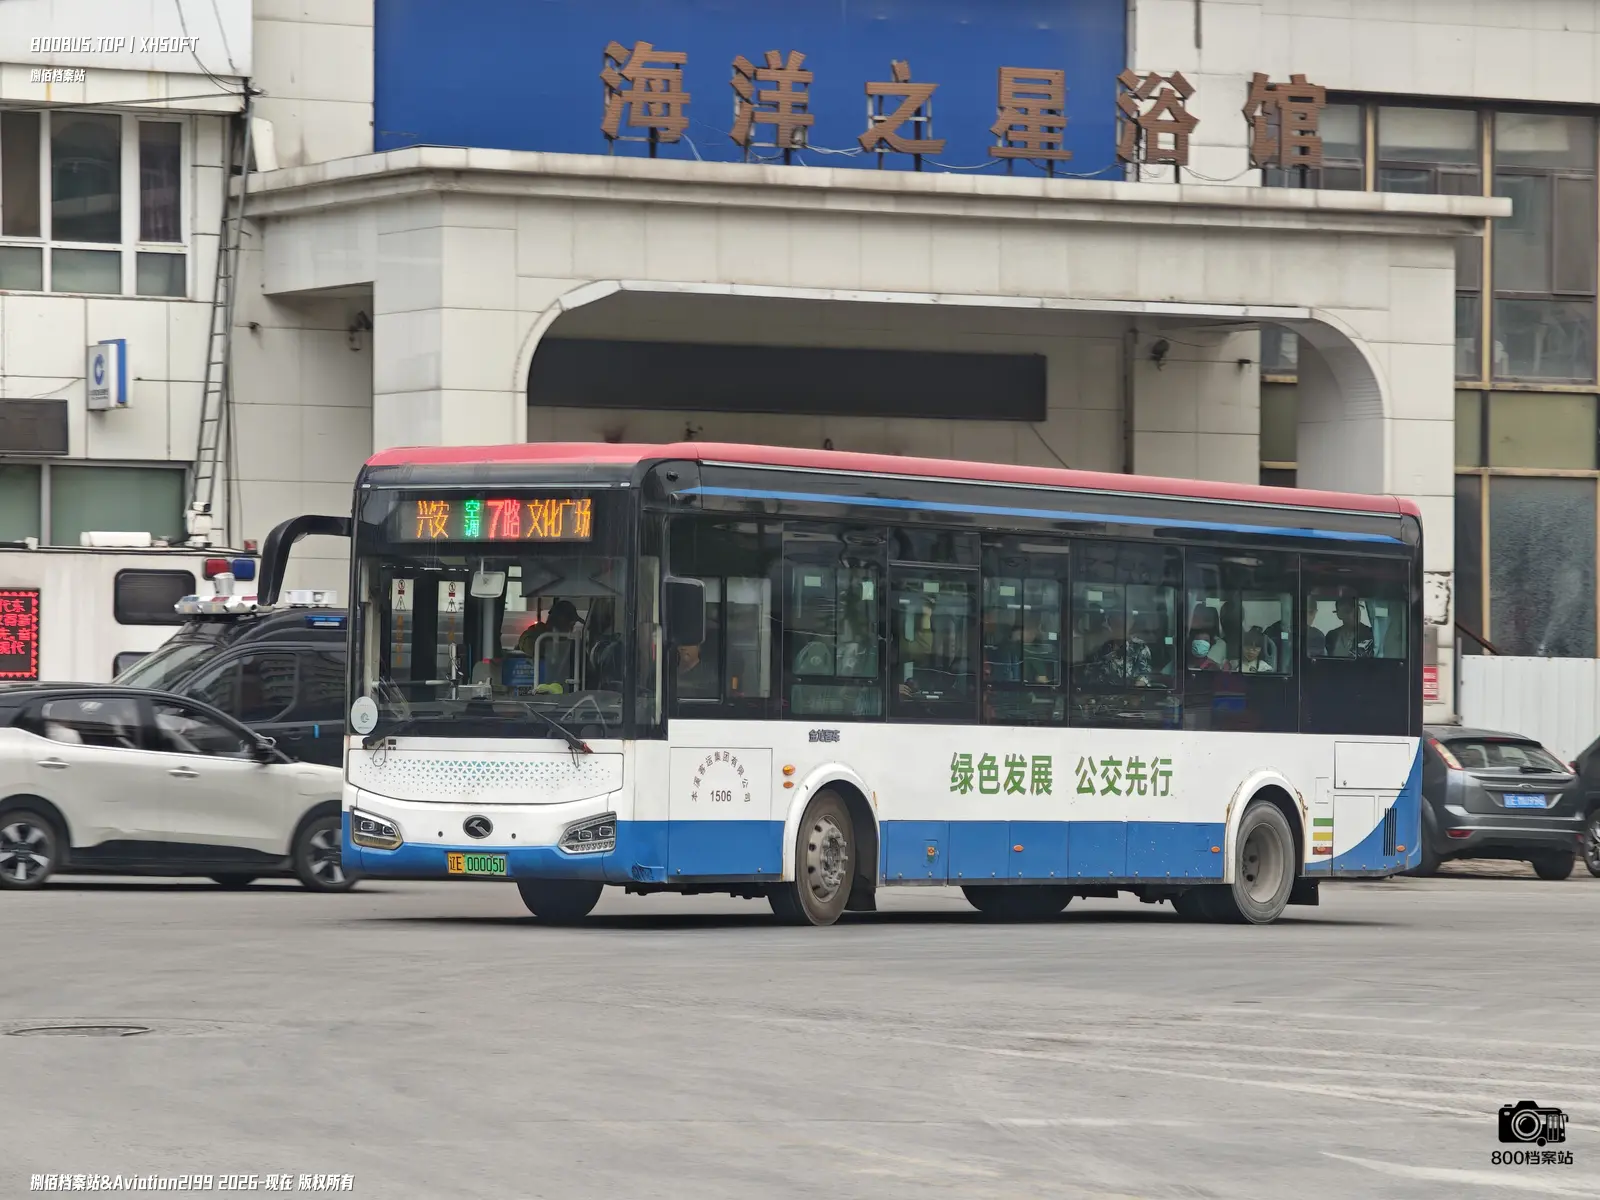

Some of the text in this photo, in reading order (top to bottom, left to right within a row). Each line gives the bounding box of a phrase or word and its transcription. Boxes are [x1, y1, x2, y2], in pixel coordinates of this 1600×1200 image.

[600, 40, 1326, 168] 海洋之星浴馆
[487, 499, 520, 538] 7路
[527, 499, 592, 538] 文化广场
[950, 752, 1173, 797] 绿色发展 公交先行
[710, 790, 732, 802] 1506
